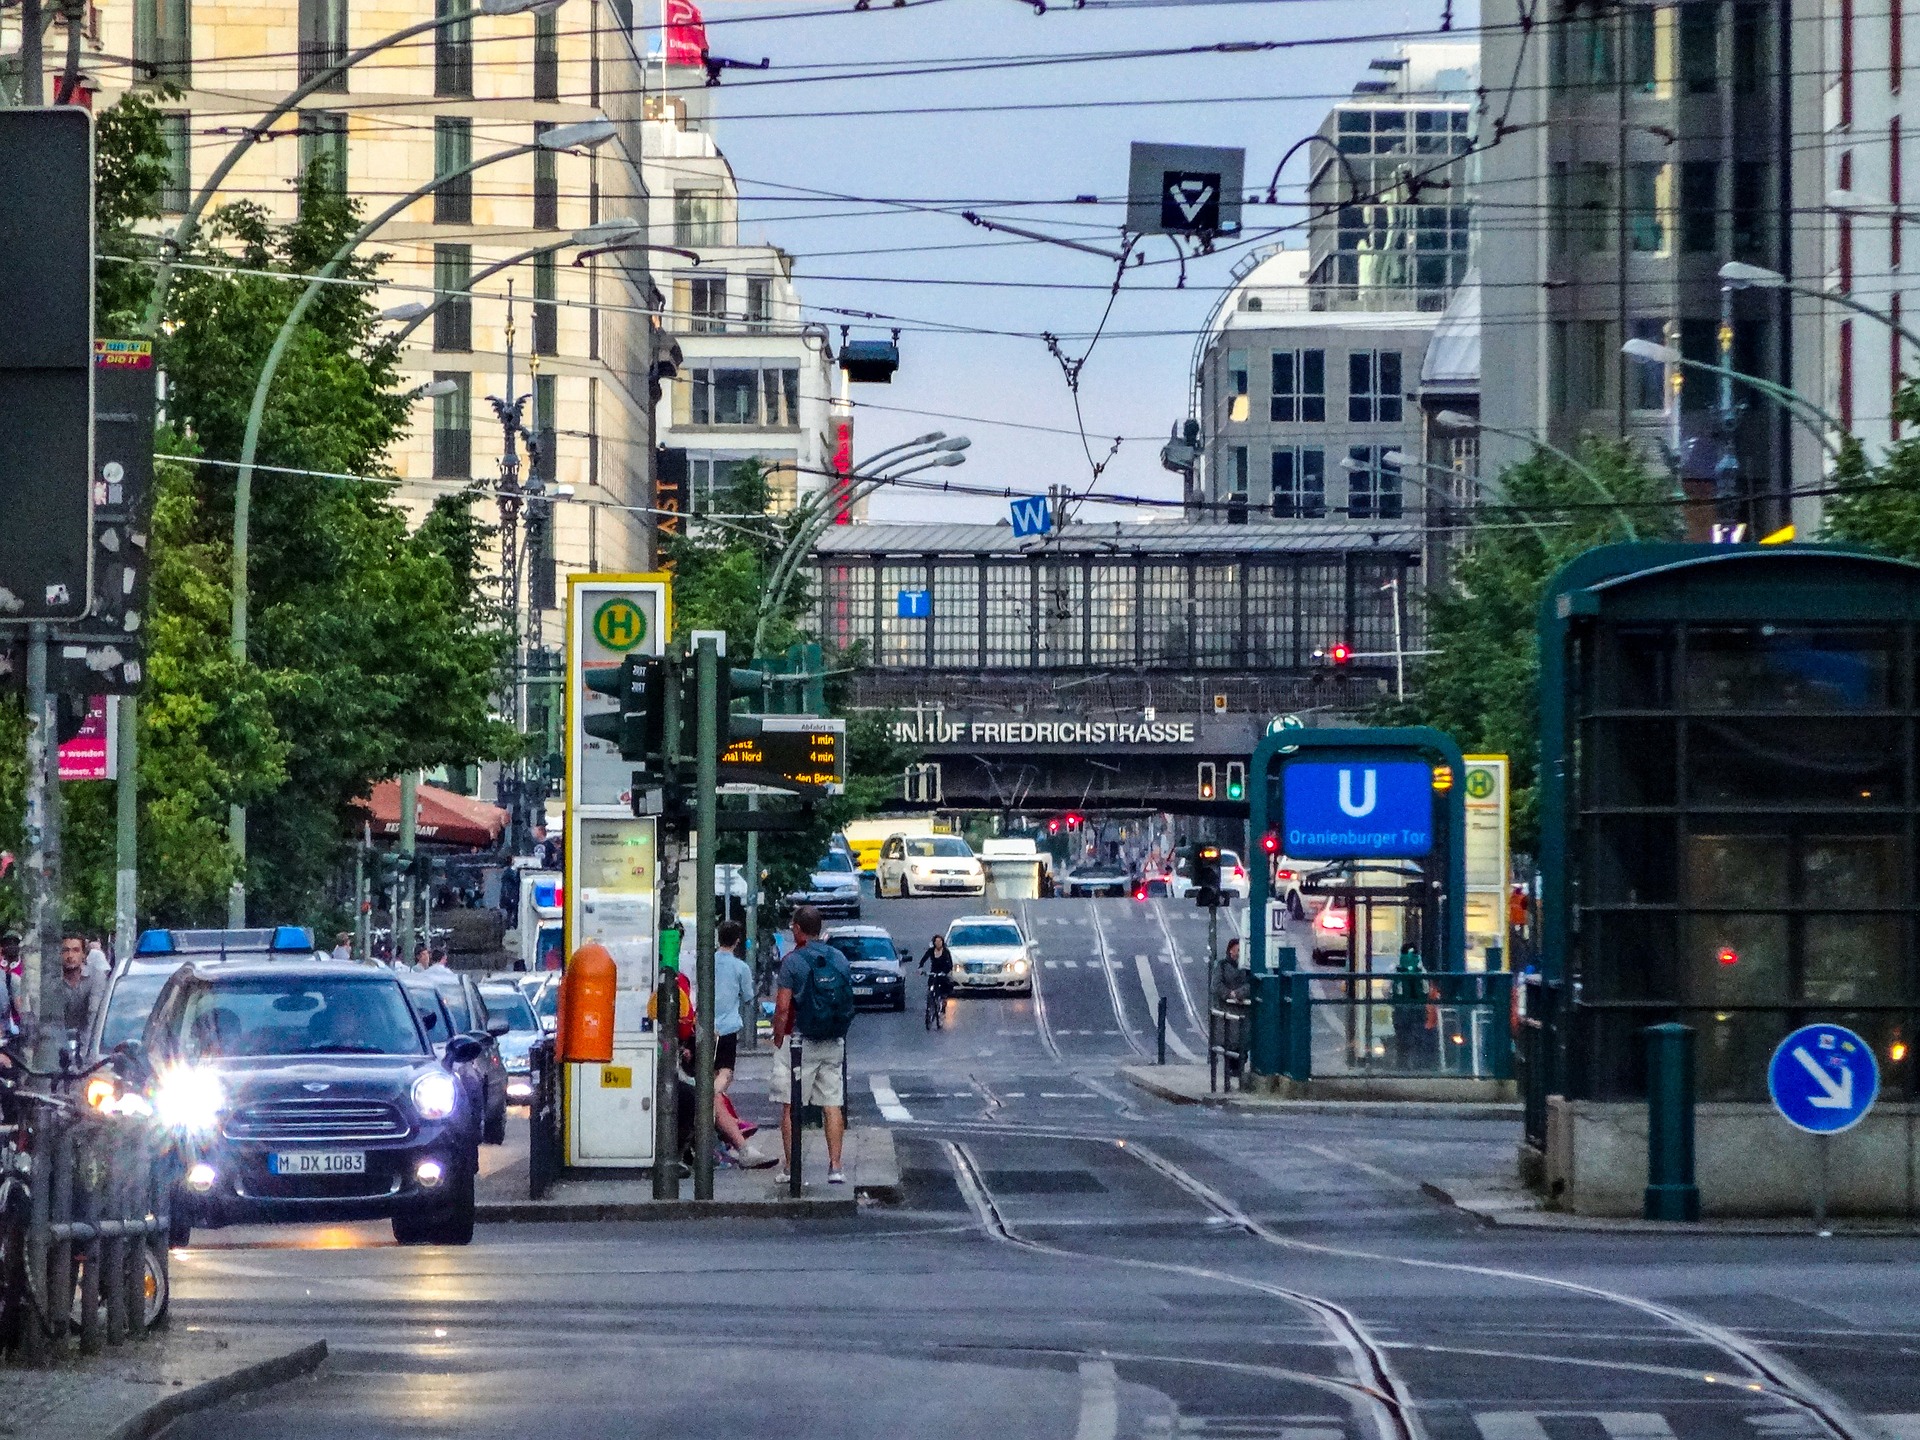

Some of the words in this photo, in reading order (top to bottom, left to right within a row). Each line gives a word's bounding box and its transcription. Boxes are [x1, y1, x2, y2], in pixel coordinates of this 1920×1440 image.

[1011, 499, 1045, 533] W
[904, 592, 923, 614] T
[607, 610, 633, 640] H
[817, 734, 834, 745] min
[971, 722, 1195, 743] FRIEDRICHSTRASSE
[741, 751, 762, 762] Nord
[817, 751, 834, 762] min
[1338, 769, 1377, 818] U
[1289, 829, 1398, 849] Oranienburger
[1402, 829, 1427, 845] Tor
[1274, 910, 1283, 930] U
[279, 1155, 290, 1171] M
[300, 1155, 320, 1172] DX
[324, 1155, 363, 1171] 1083
